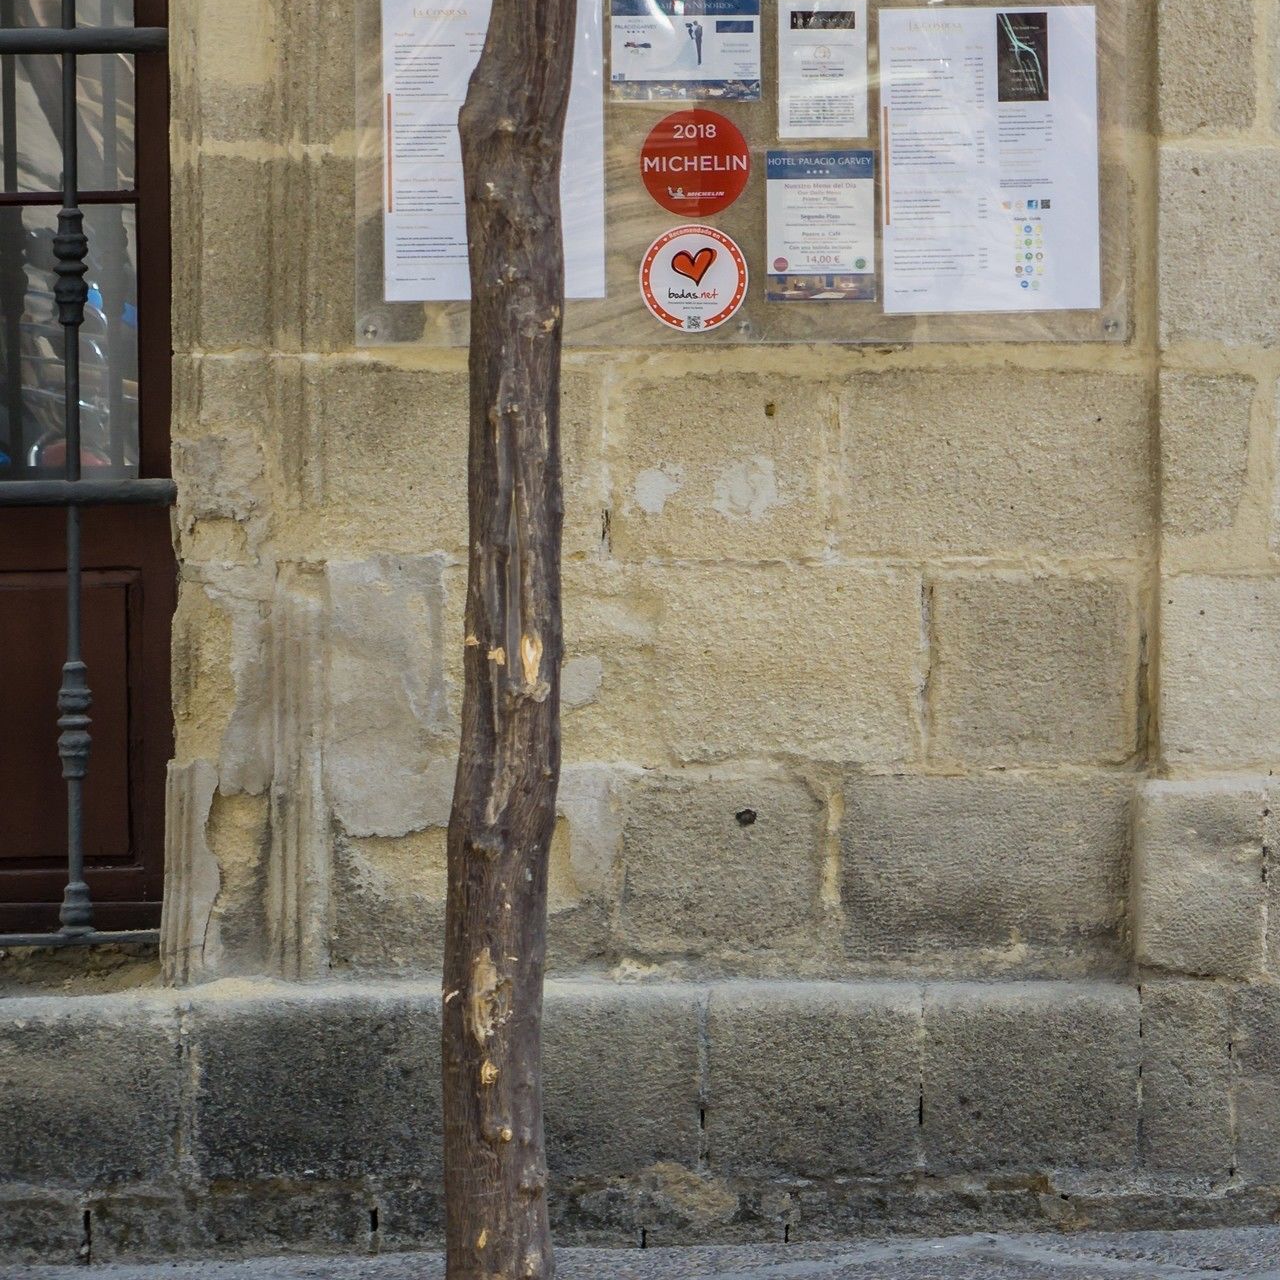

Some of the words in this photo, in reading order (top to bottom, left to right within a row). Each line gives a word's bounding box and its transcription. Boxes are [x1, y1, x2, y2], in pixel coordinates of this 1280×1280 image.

[673, 124, 717, 138] 2018
[643, 155, 747, 172] MICHELIN
[768, 158, 796, 166] HOTEL
[799, 158, 836, 166] PALACIO
[838, 157, 872, 165] GARVEY
[668, 287, 719, 299] bodas.net
